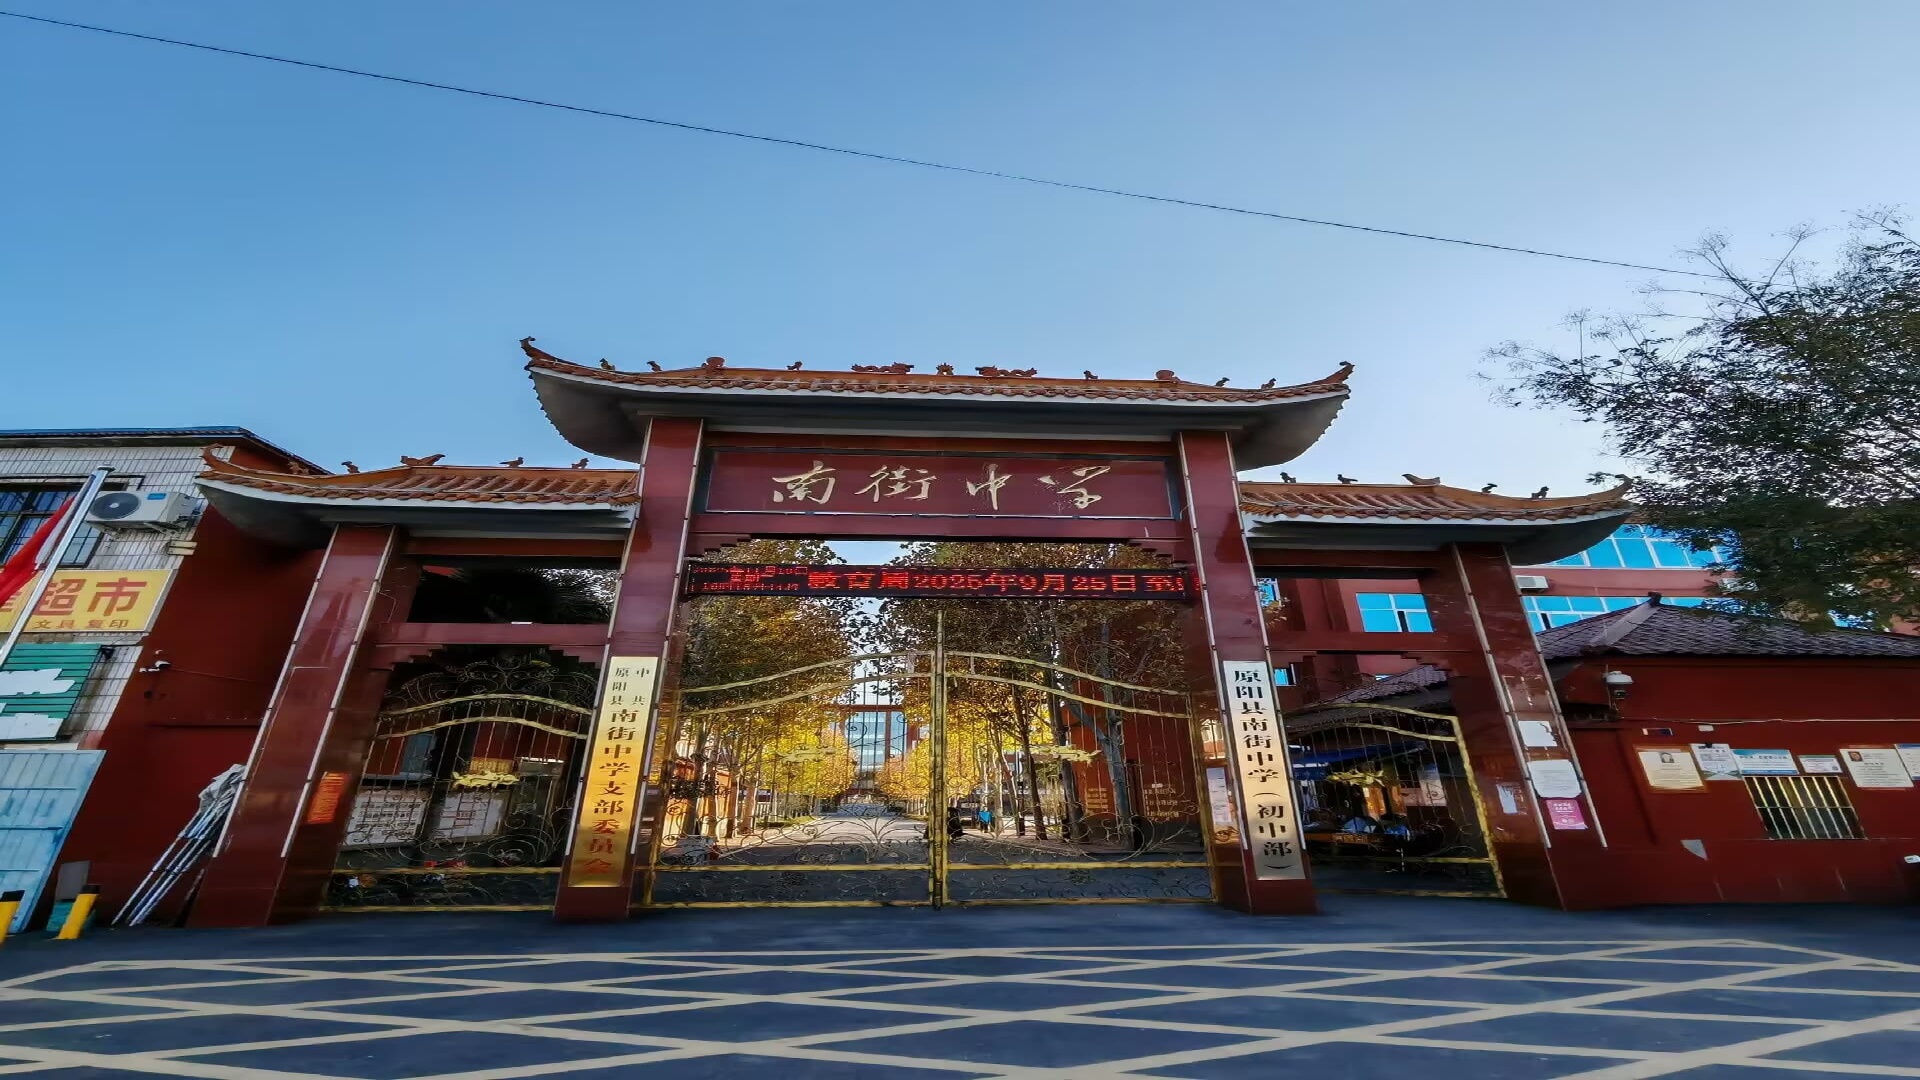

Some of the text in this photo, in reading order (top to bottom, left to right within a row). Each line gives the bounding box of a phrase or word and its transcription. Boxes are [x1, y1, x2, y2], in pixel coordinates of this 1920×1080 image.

[772, 460, 1112, 511] 南街中学
[0, 577, 148, 617] 超市
[33, 619, 129, 629] 文具 复印
[609, 667, 630, 706] 原阳县
[632, 667, 650, 706] 中共
[582, 708, 640, 874] 南街中学支部委员会
